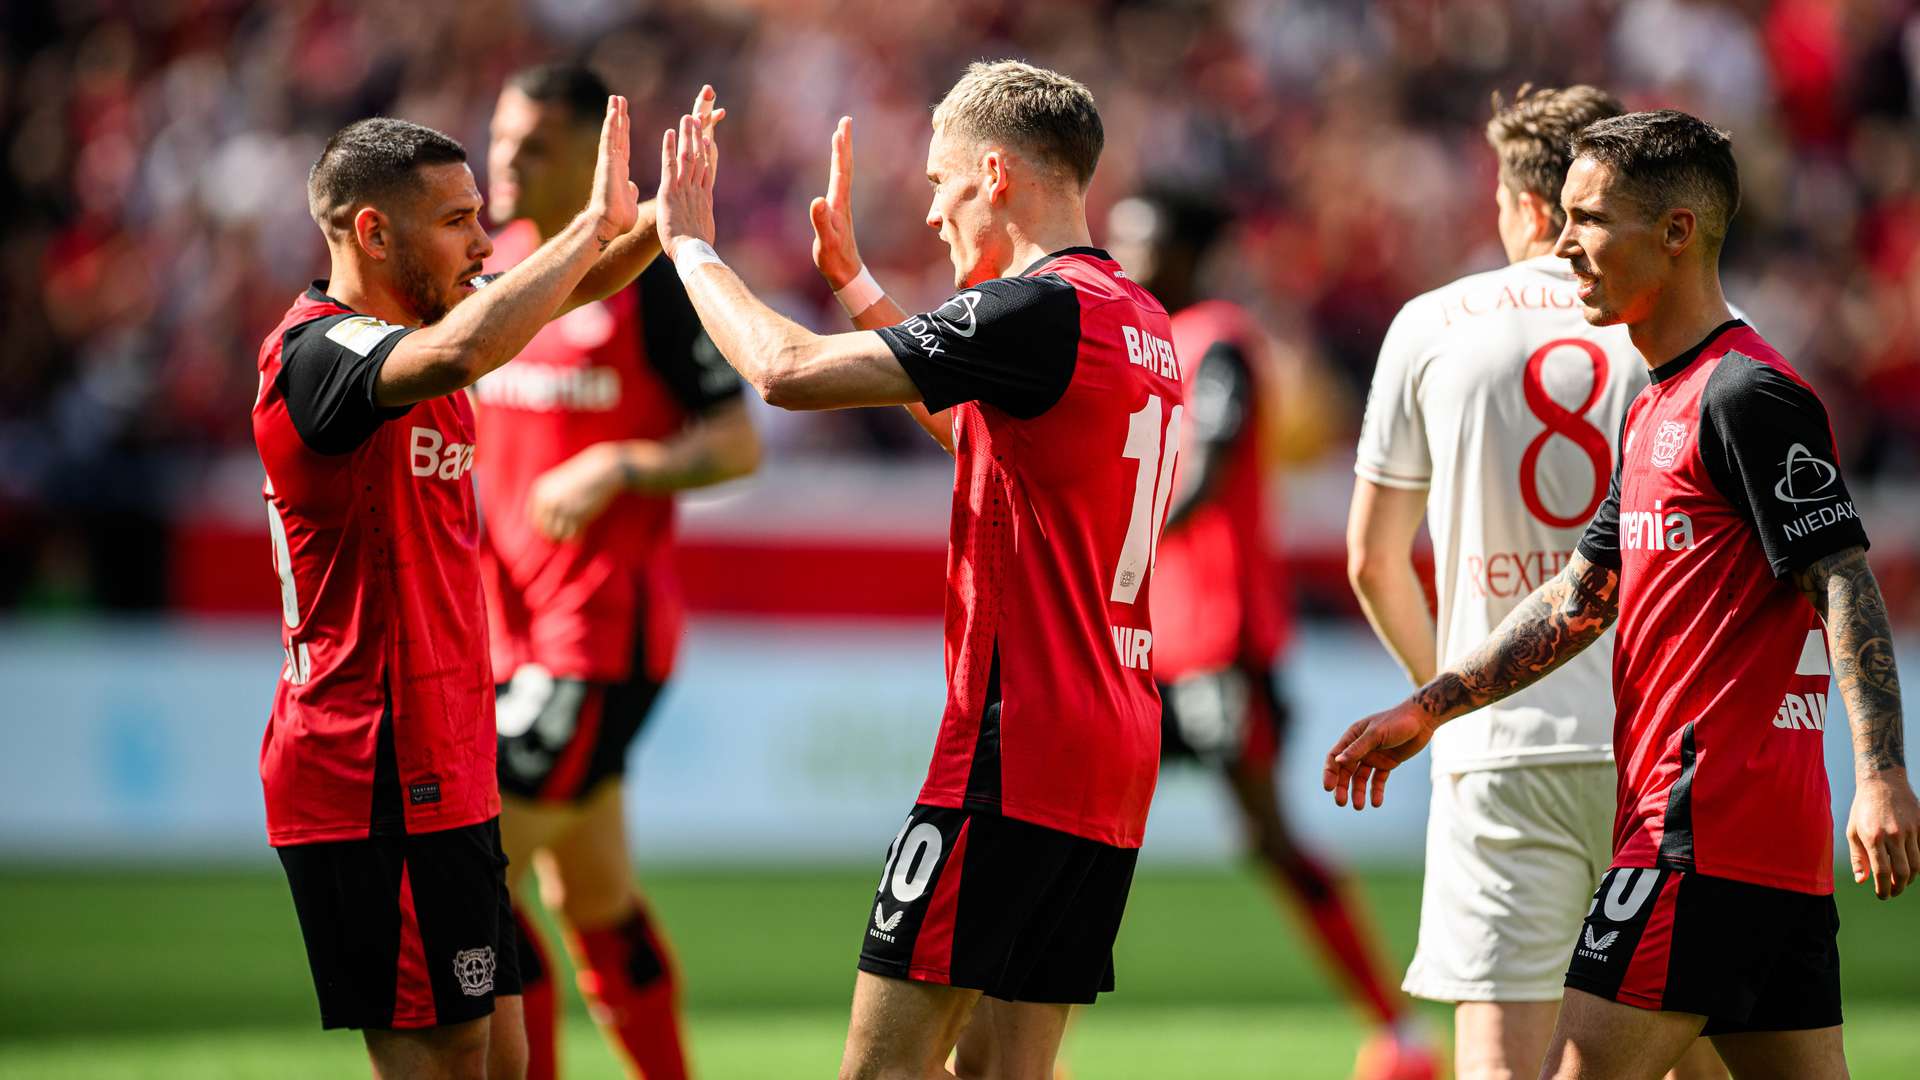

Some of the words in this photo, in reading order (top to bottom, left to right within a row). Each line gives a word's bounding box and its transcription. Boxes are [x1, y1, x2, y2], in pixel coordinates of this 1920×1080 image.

[1496, 285, 1584, 310] AUG
[1122, 325, 1179, 381] BAYER
[1520, 338, 1613, 529] 8
[1782, 500, 1859, 541] NIEDAX
[1467, 550, 1574, 600] REXH
[869, 928, 896, 944] CASTORE
[1578, 949, 1609, 963] CASTORE
